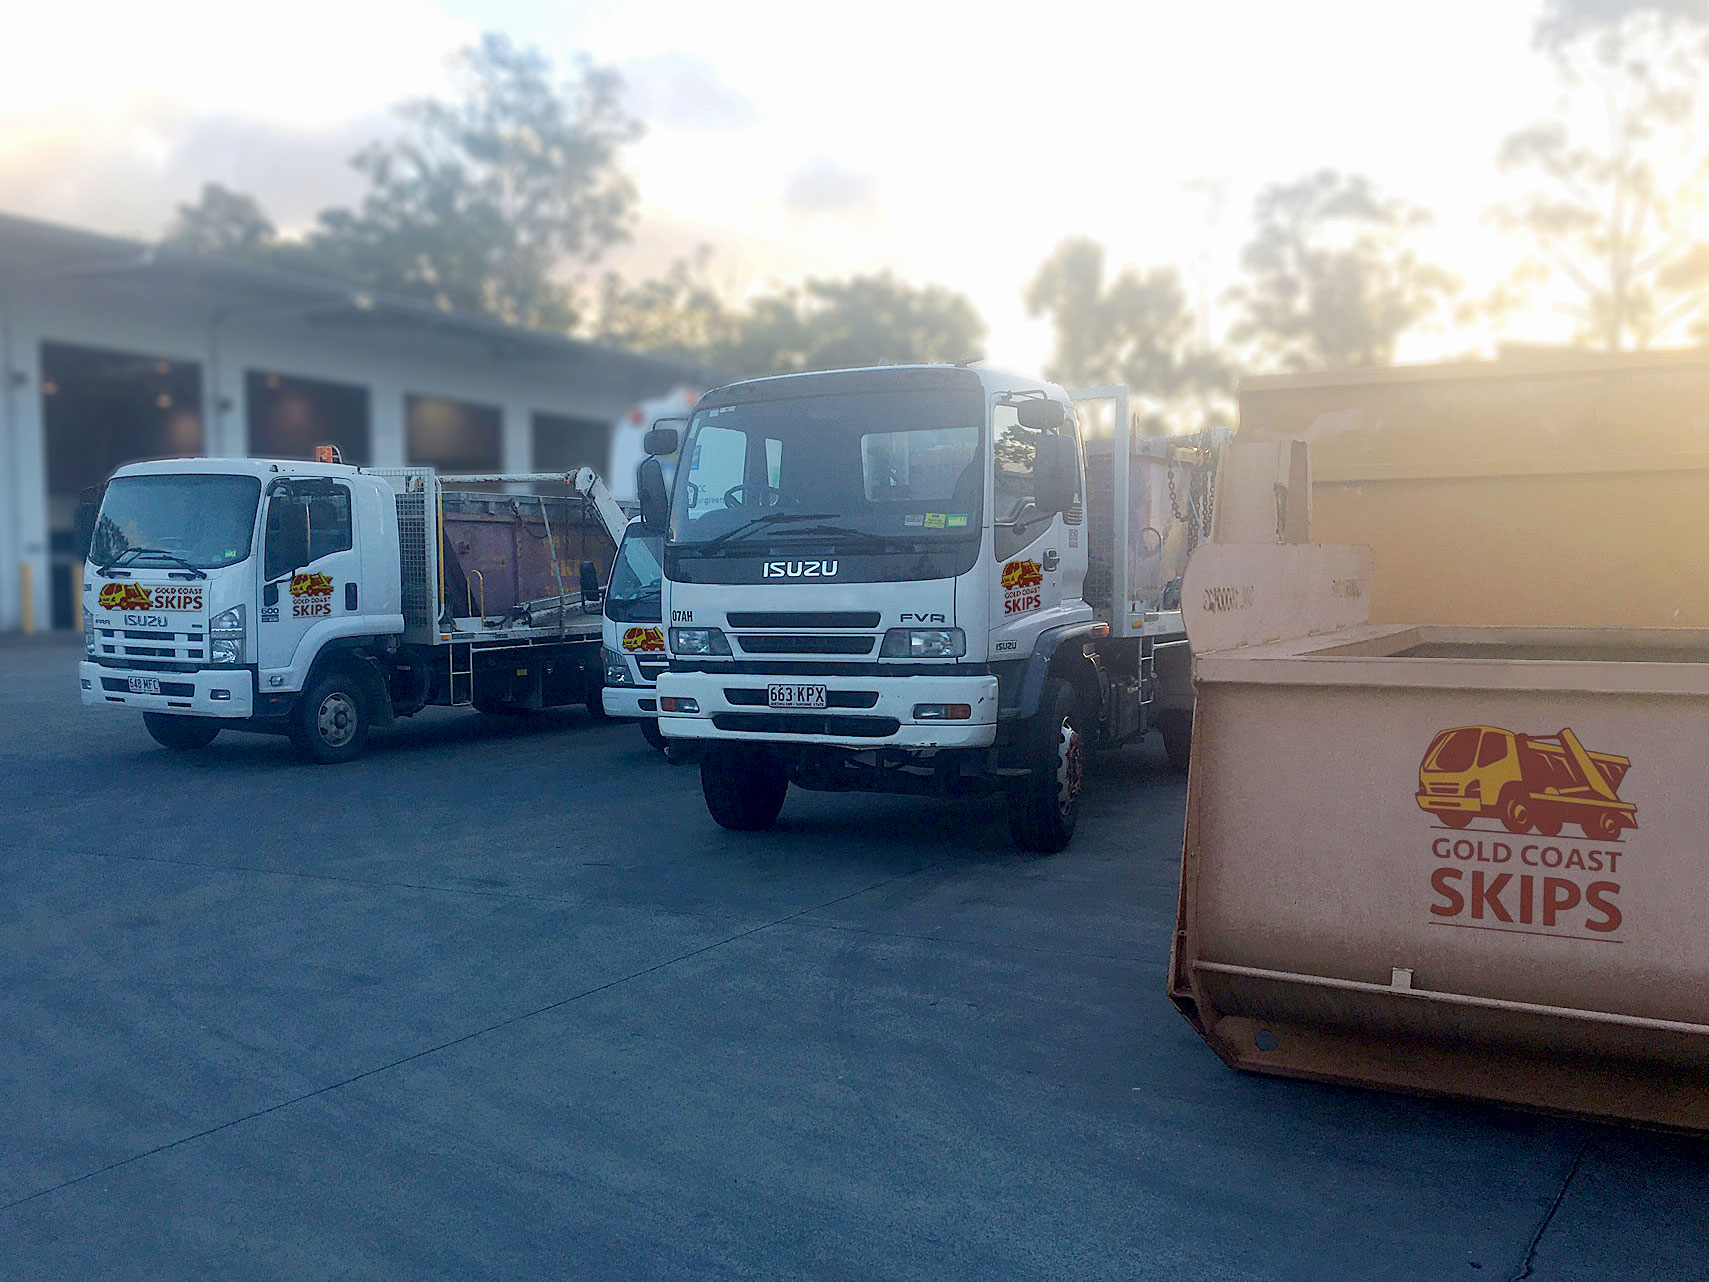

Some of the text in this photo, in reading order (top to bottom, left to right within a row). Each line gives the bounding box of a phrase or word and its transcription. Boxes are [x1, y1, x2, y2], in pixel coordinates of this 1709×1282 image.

[763, 560, 839, 578] ISUZU
[177, 587, 203, 595] COAST
[1004, 590, 1022, 599] GOLD
[154, 595, 203, 609] SKIPS
[1004, 594, 1041, 614] SKIPS
[292, 603, 332, 616] SKIPS
[672, 609, 694, 622] 07AH
[124, 614, 169, 628] ISUZU
[900, 613, 946, 623] FVR
[995, 641, 1017, 651] ISUZU
[1431, 837, 1623, 873] GOLD COAST
[1429, 866, 1623, 933] SKIPS
